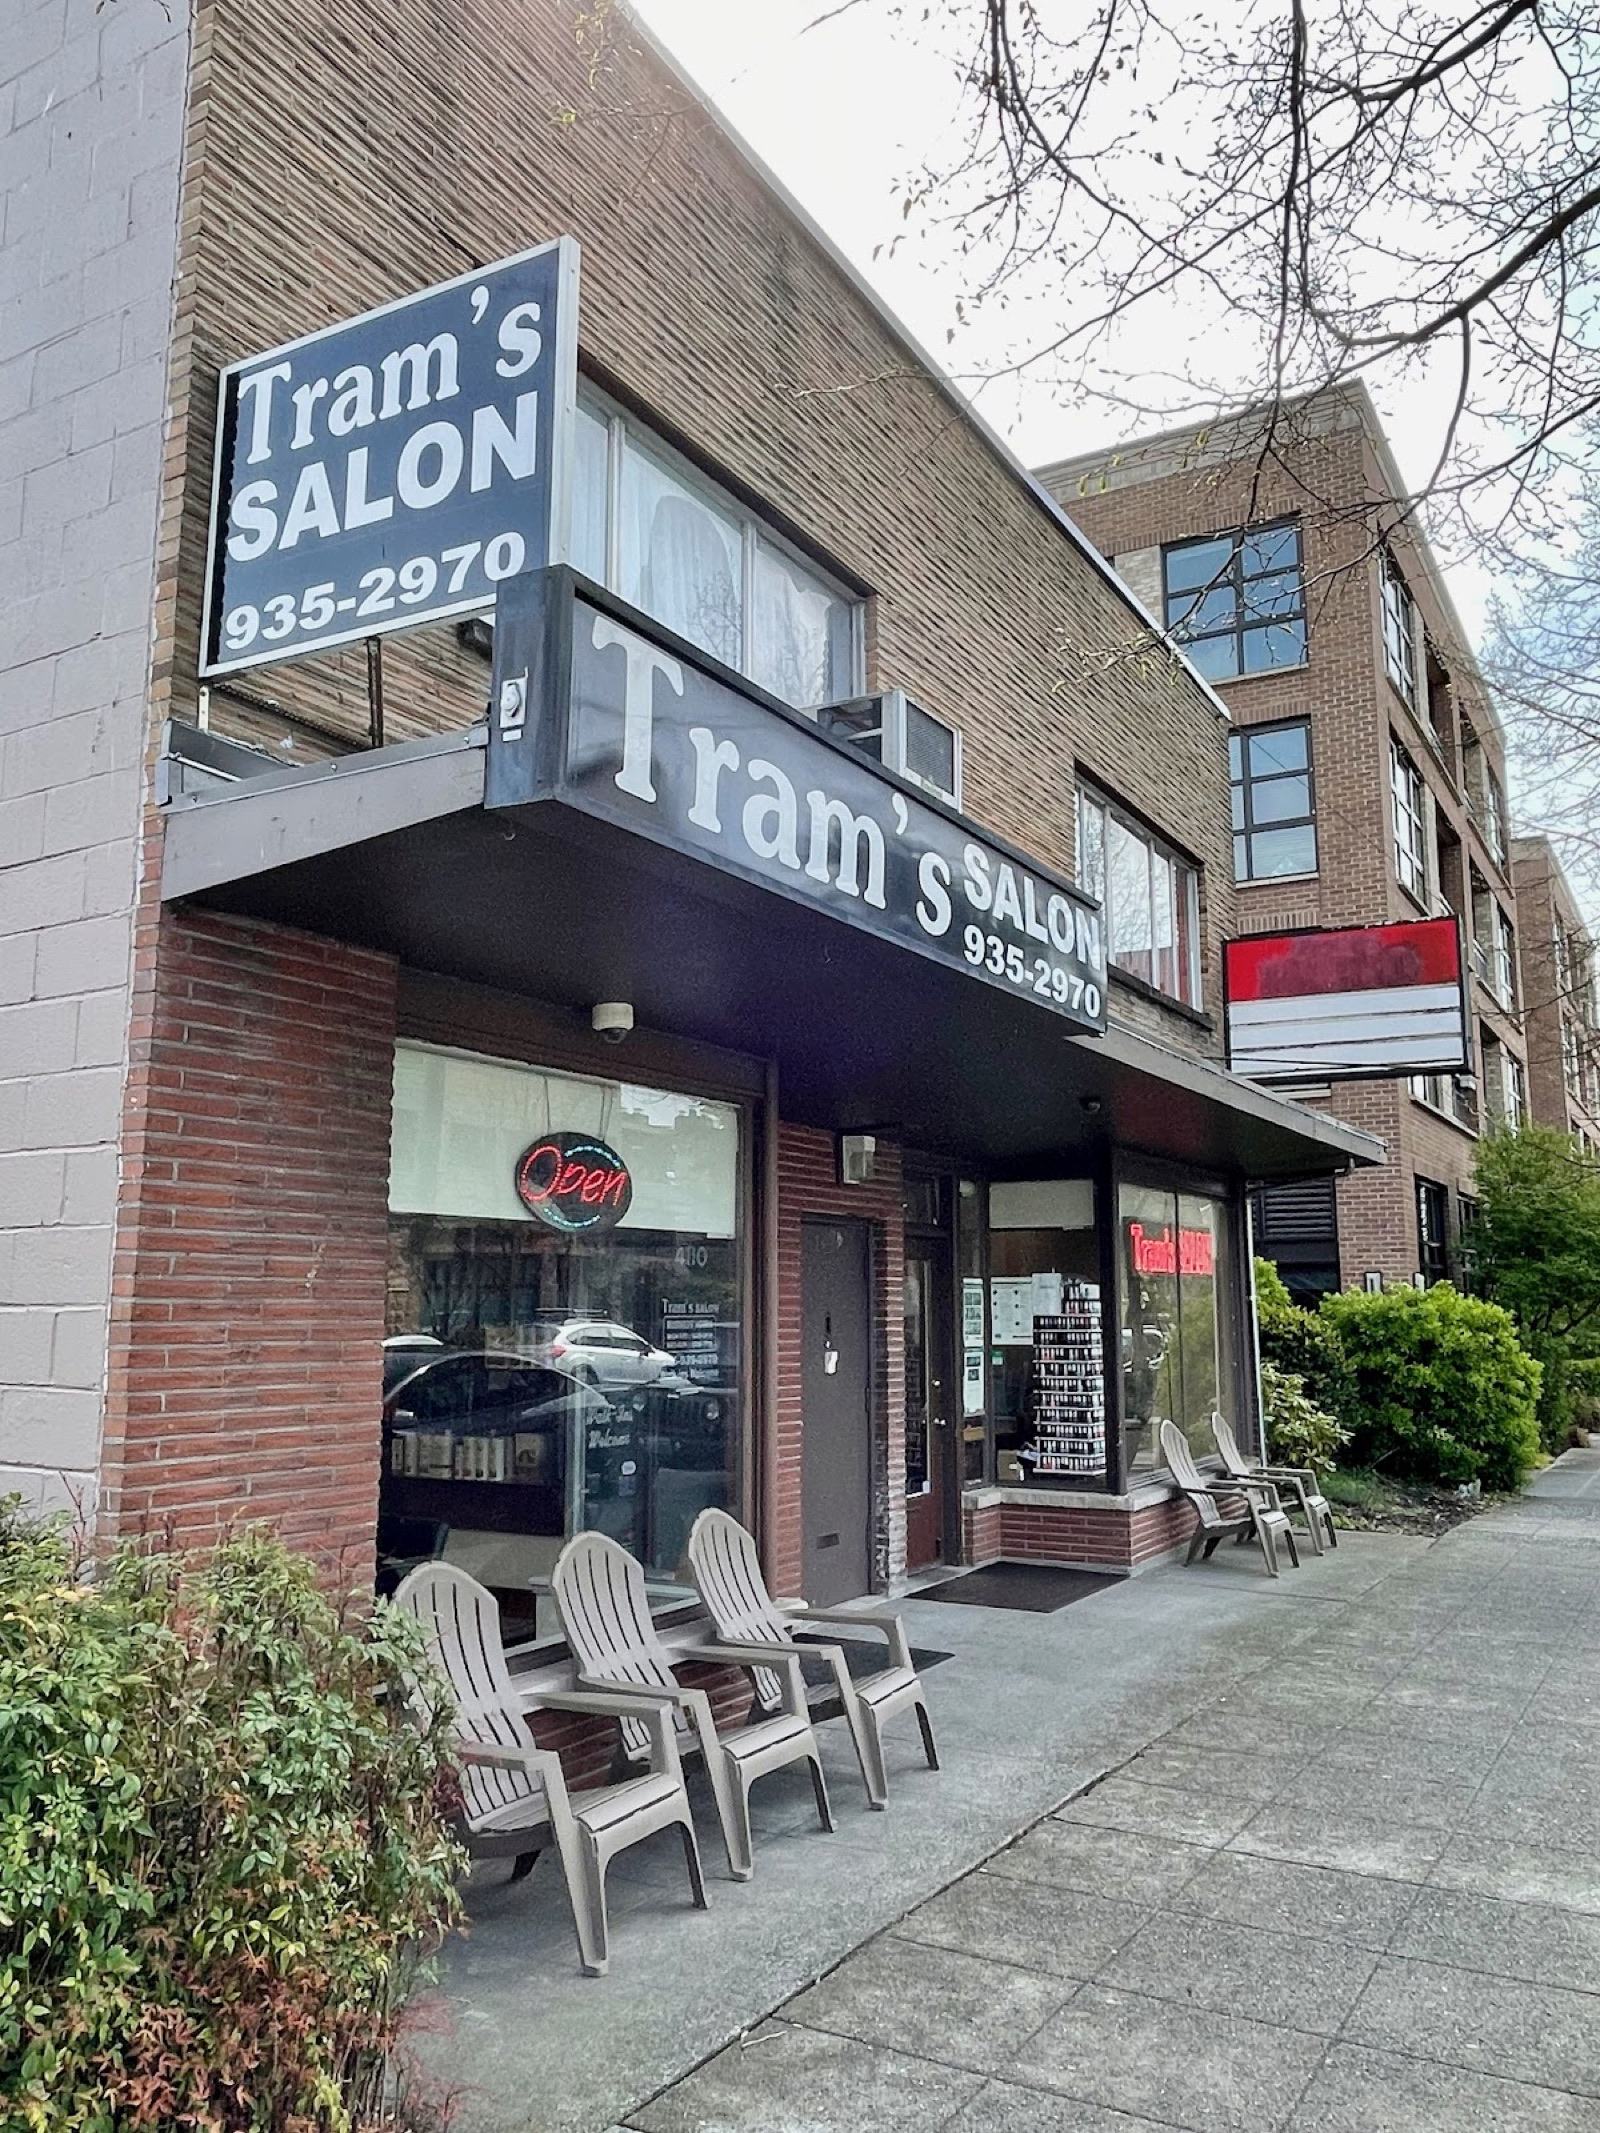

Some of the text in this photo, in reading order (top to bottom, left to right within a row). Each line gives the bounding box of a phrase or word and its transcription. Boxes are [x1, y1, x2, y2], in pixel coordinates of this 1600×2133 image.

[237, 284, 542, 465] Tram's
[226, 391, 539, 562] SALON
[224, 531, 526, 650] 935-2970
[592, 614, 952, 938] Tram's
[963, 843, 1101, 971] SALON
[963, 924, 1100, 1018] 935-2970
[520, 1145, 627, 1206] Open
